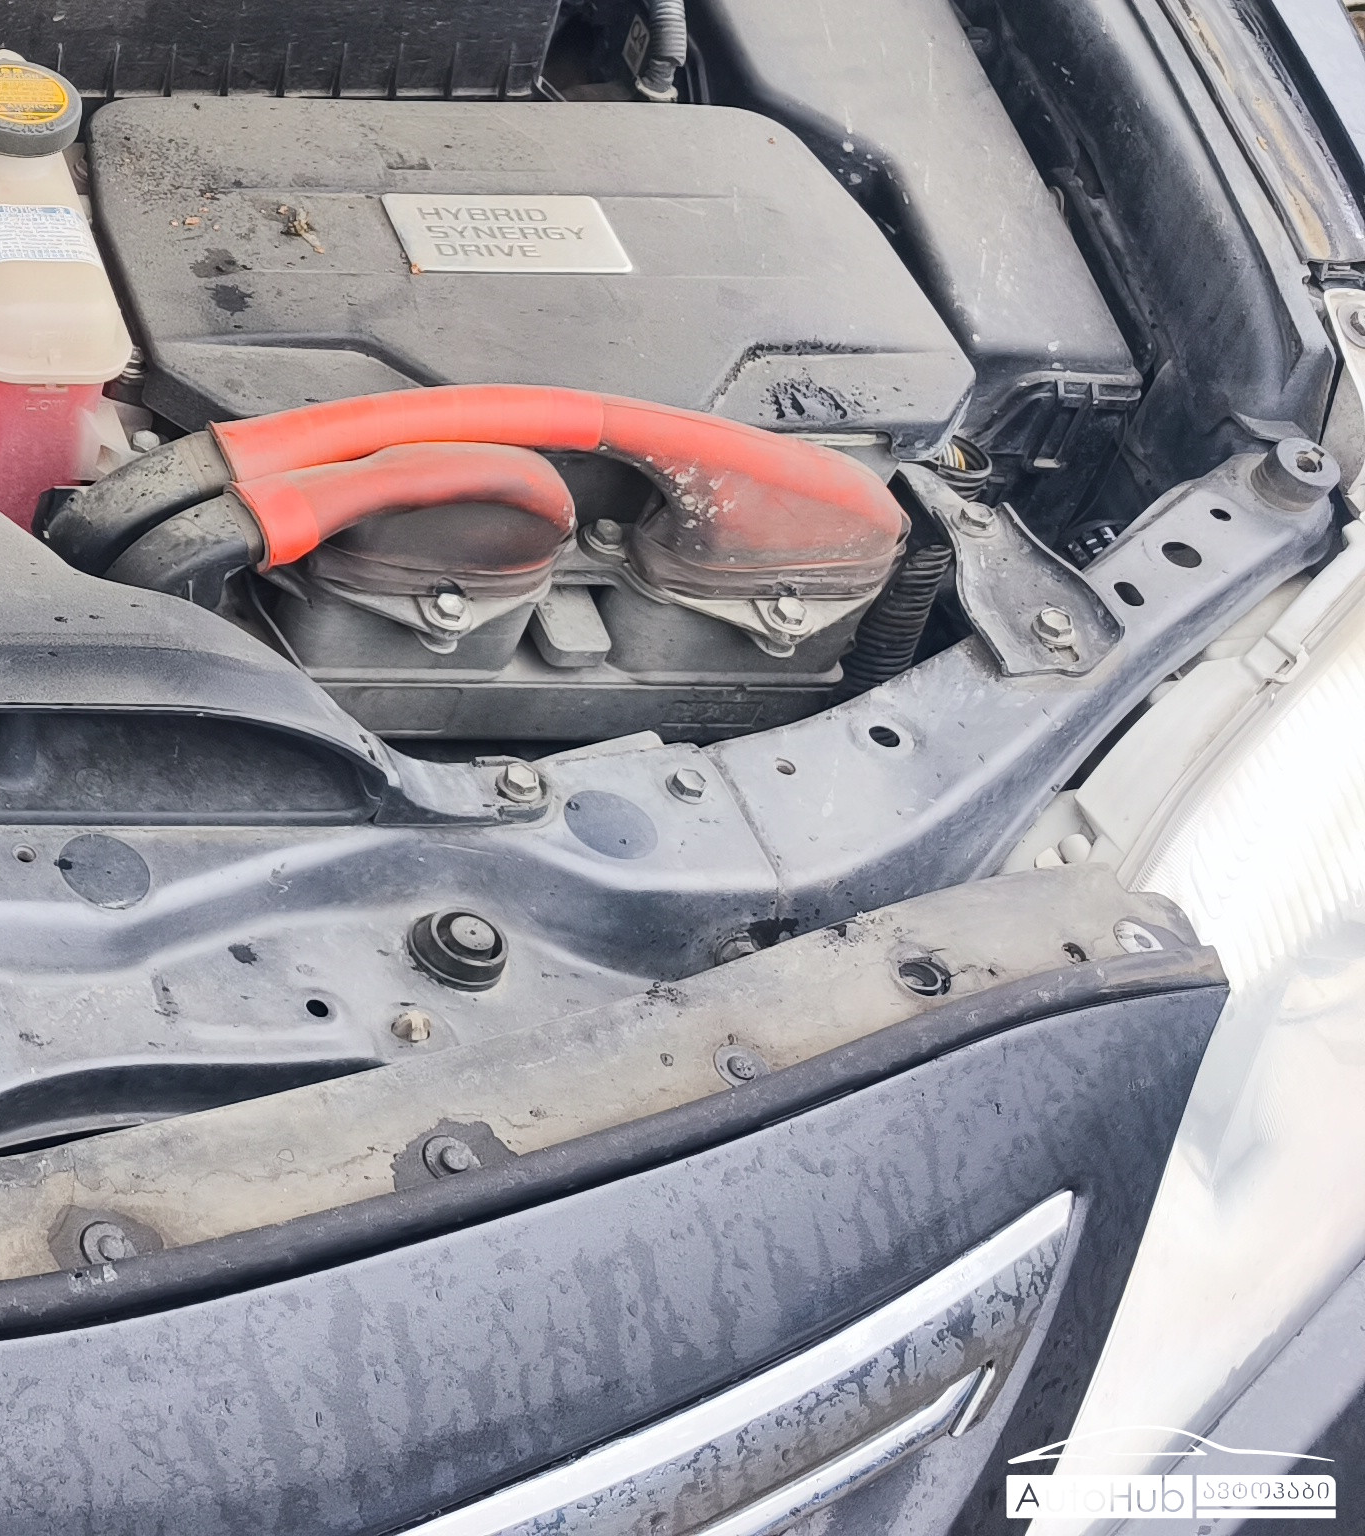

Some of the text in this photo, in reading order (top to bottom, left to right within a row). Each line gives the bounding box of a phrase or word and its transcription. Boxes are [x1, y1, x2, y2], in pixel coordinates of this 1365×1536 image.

[417, 207, 548, 223] HYBRID
[425, 225, 584, 241] SYNERGY
[434, 243, 542, 258] DRIVE
